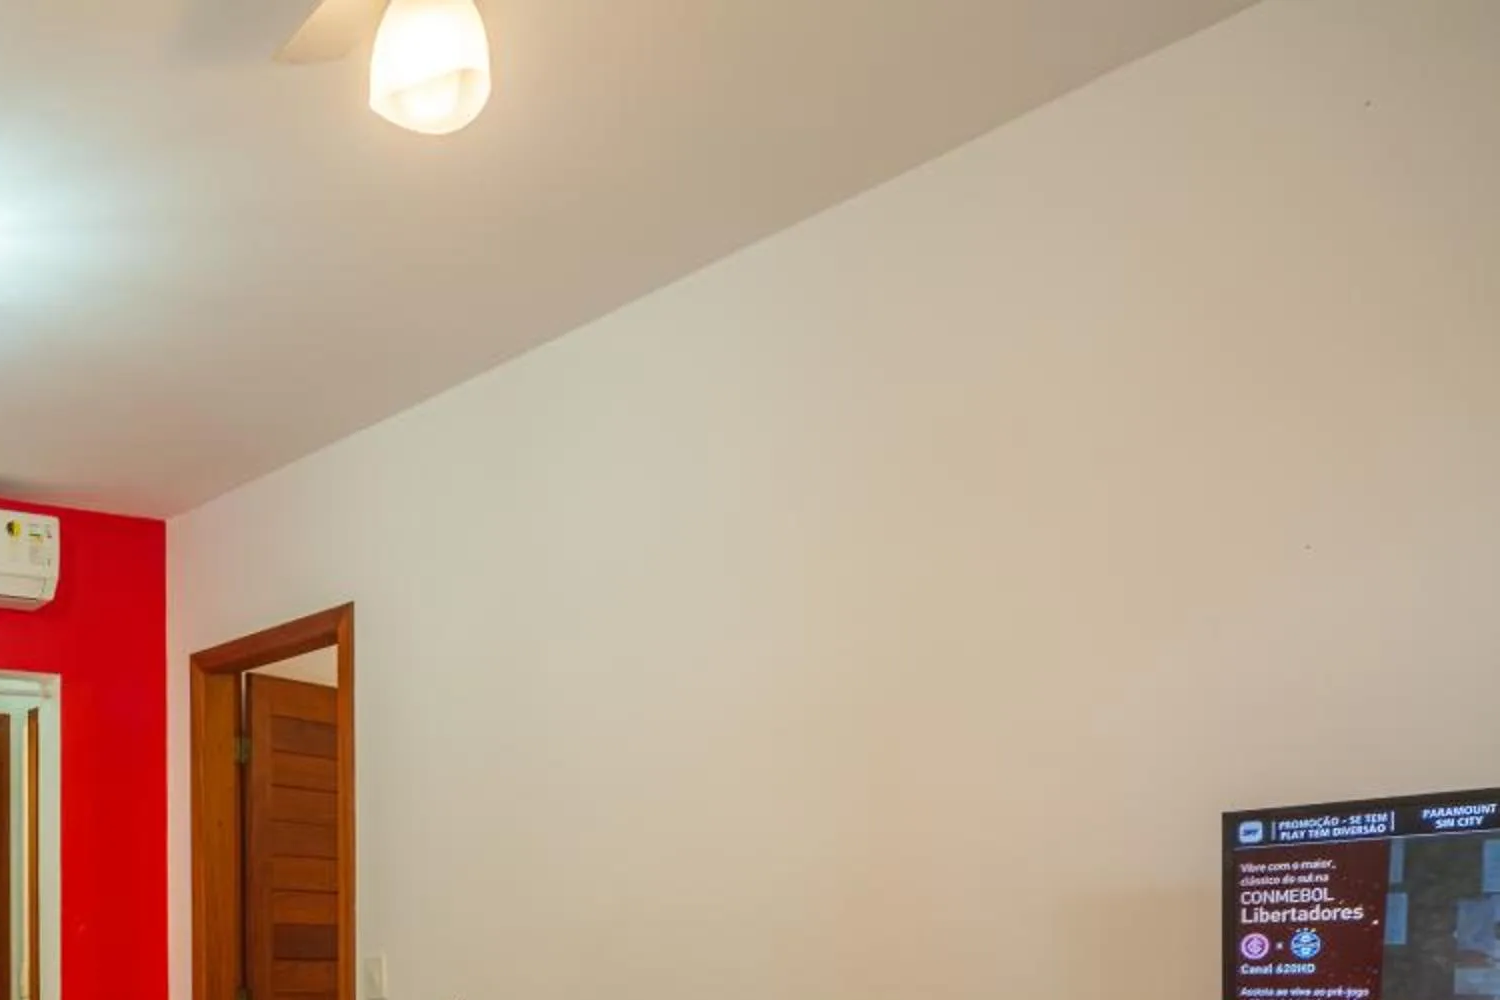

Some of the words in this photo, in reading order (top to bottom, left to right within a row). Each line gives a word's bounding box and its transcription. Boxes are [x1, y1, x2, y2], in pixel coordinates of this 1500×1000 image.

[1422, 803, 1498, 818] PARAMOUNT
[1458, 815, 1484, 827] CITY
[1280, 830, 1305, 841] PLAY
[1240, 888, 1334, 905] CONMEBOL
[1240, 904, 1364, 923] Libertadores
